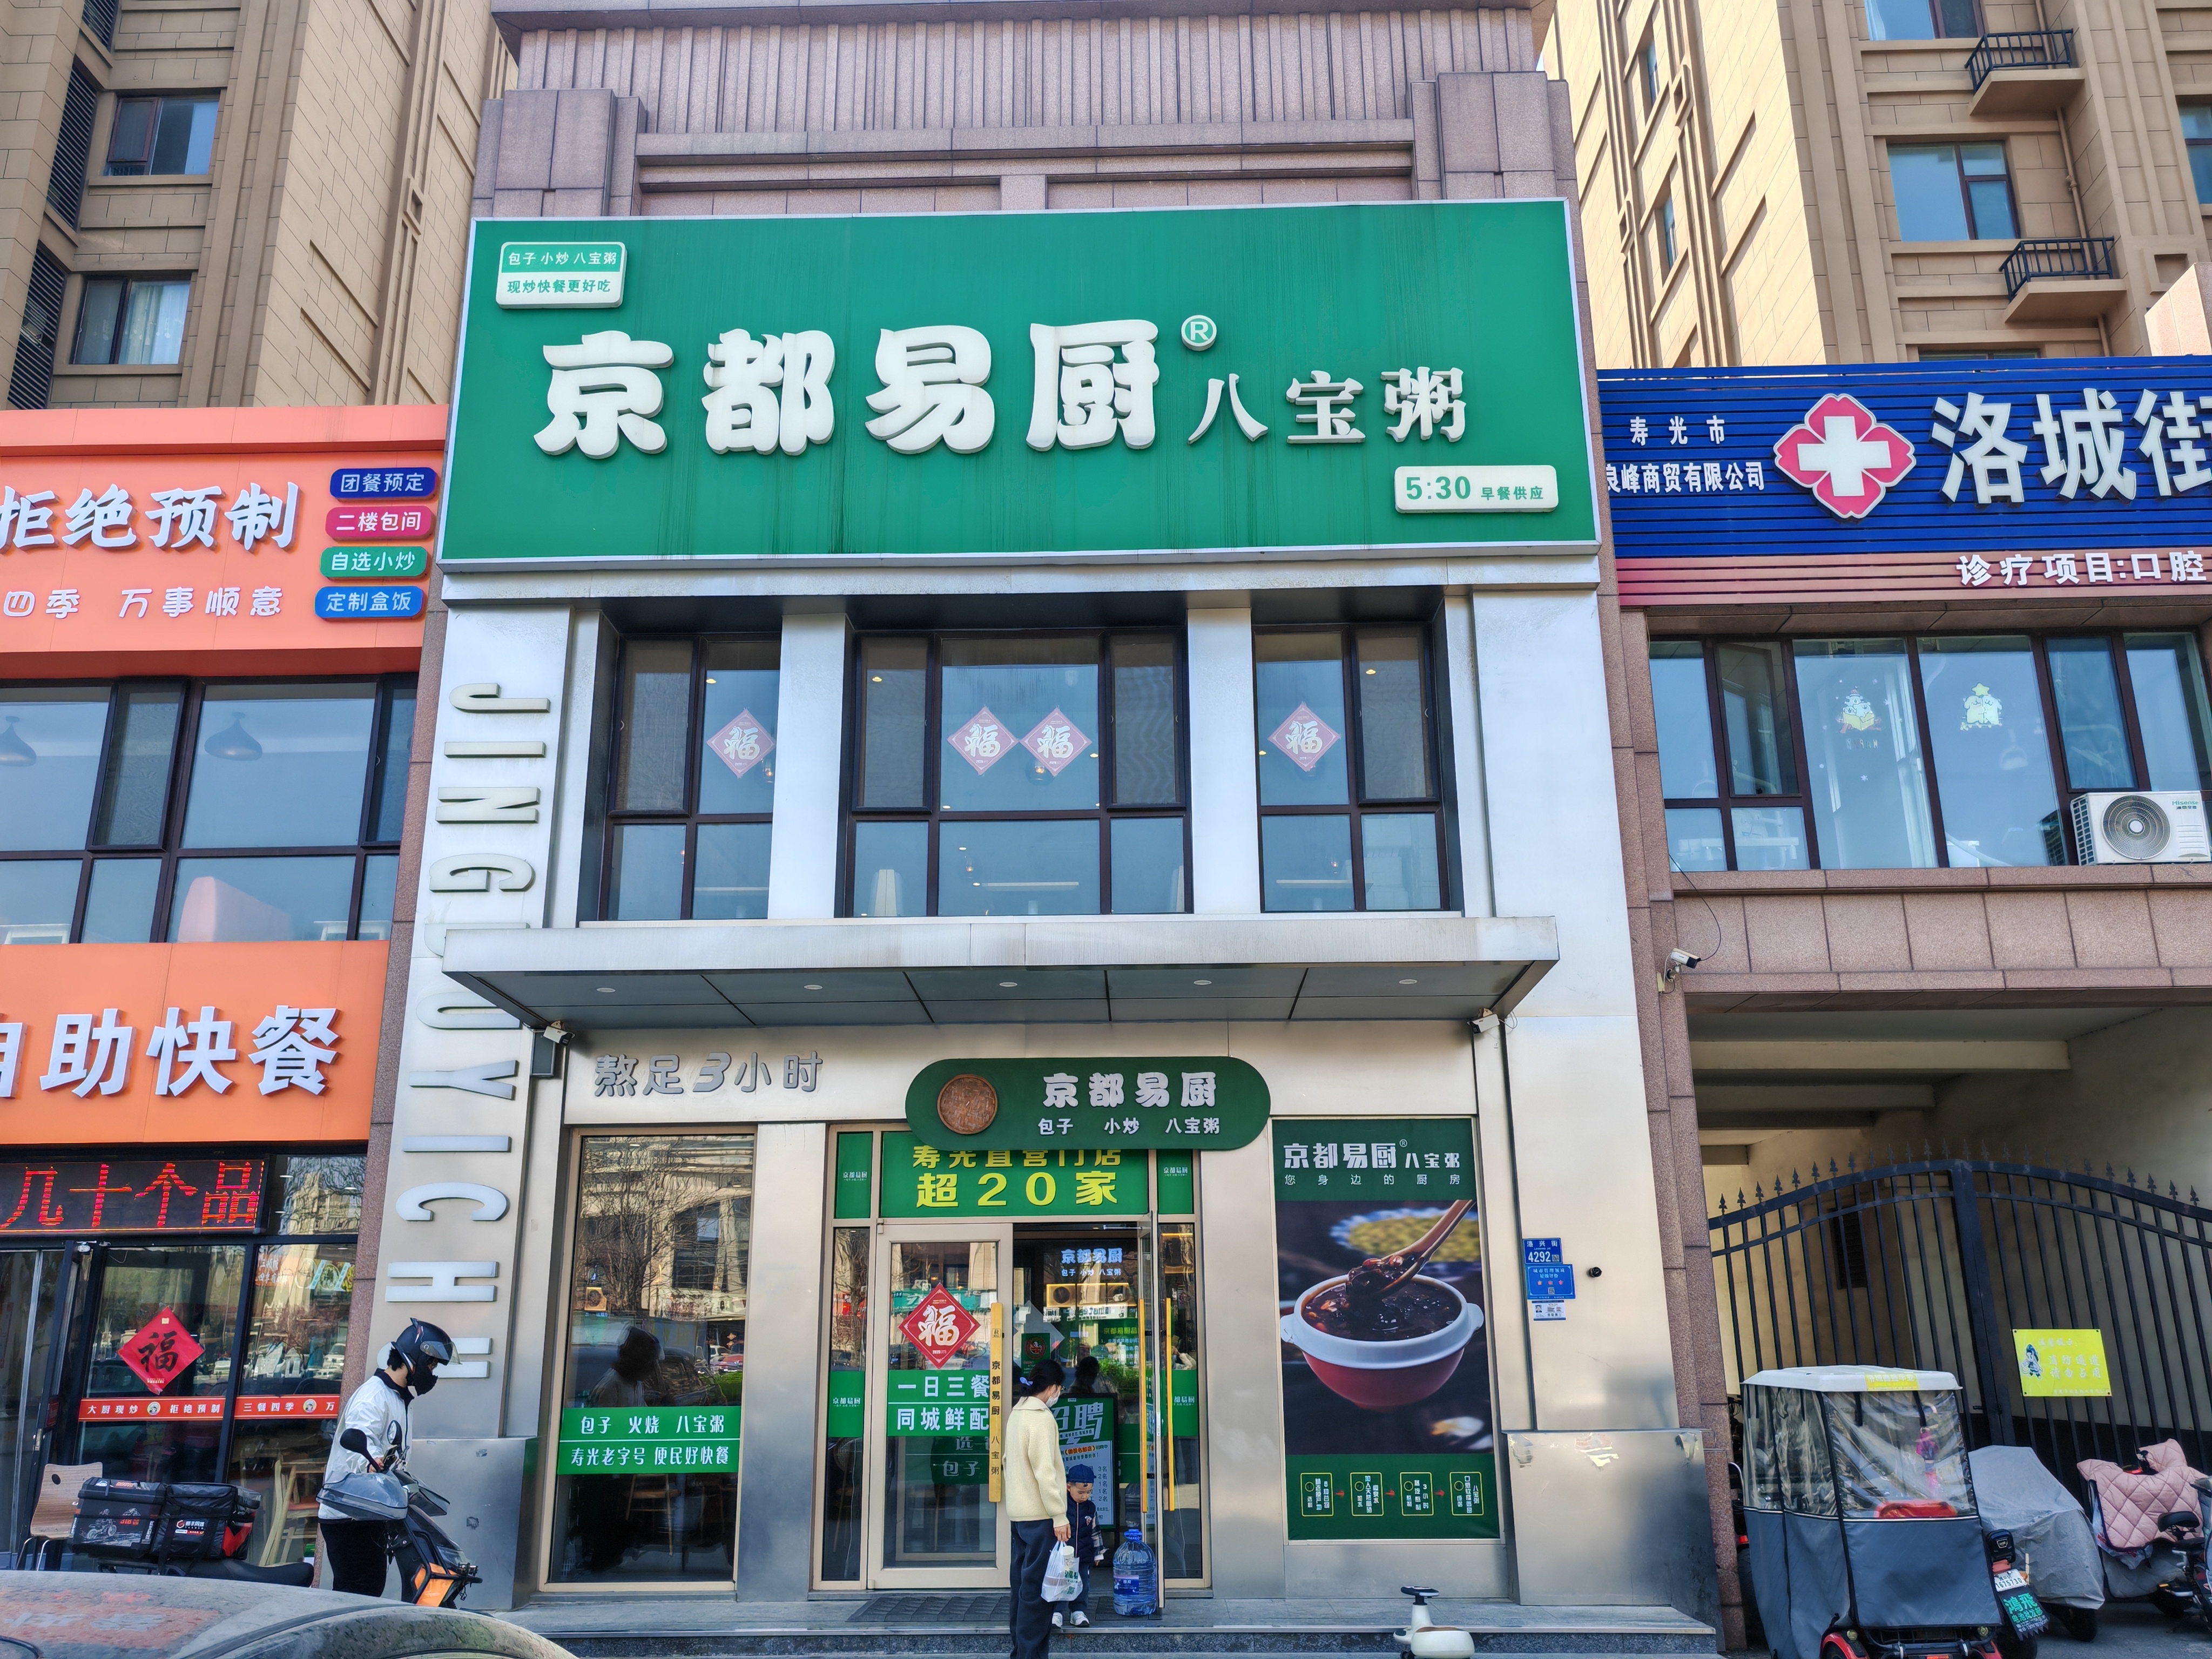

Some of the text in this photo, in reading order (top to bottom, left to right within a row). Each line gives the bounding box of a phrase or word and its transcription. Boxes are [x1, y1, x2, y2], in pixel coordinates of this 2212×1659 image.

[508, 249, 617, 266] 包子 小炒 八宝粥
[507, 279, 611, 294] 现炒快餐更好吃
[534, 319, 1159, 459] 京都易厨
[1188, 367, 1465, 444] 八宝粥
[1630, 415, 1725, 446] 寿光市
[1930, 388, 2212, 505] 洛城街
[341, 473, 425, 494] 团餐预定
[1406, 475, 1544, 501] 5:30 早餐供应
[1606, 461, 1765, 494] 良峰商贸有限公司
[0, 482, 300, 552] 拒绝预制
[336, 511, 422, 532] 二楼包间
[331, 552, 416, 571] 自选小炒
[3, 586, 284, 619] 四季 万事顺意
[325, 591, 412, 612] 定制盒饭
[724, 726, 760, 760] 福
[965, 723, 1001, 758] 福
[1037, 725, 1074, 759] 福
[1285, 720, 1323, 754] 福
[595, 1051, 824, 1097] 熬足3小时
[1042, 1071, 1217, 1109] 京都易厨
[1038, 1117, 1220, 1136] 包子 小炒 八宝粥
[1284, 1143, 1397, 1169] 京都易厨
[1405, 1152, 1460, 1169] 八宝粥
[1, 1163, 259, 1228] 几十个品
[916, 1170, 1117, 1208] 超20家
[1284, 1174, 1461, 1186] 您身边的厨房
[1061, 1248, 1123, 1264] 京都易厨
[1528, 1251, 1551, 1263] 4292
[918, 1304, 960, 1347] 福
[138, 1331, 179, 1373] 福
[992, 1361, 1000, 1415] 京都易厨
[581, 1414, 725, 1434] 包子 火烧 八宝粥
[571, 1446, 729, 1467] 寿光老字号 便民好快餐
[943, 1460, 981, 1476] 包子
[992, 1435, 1000, 1475] 八宝粥
